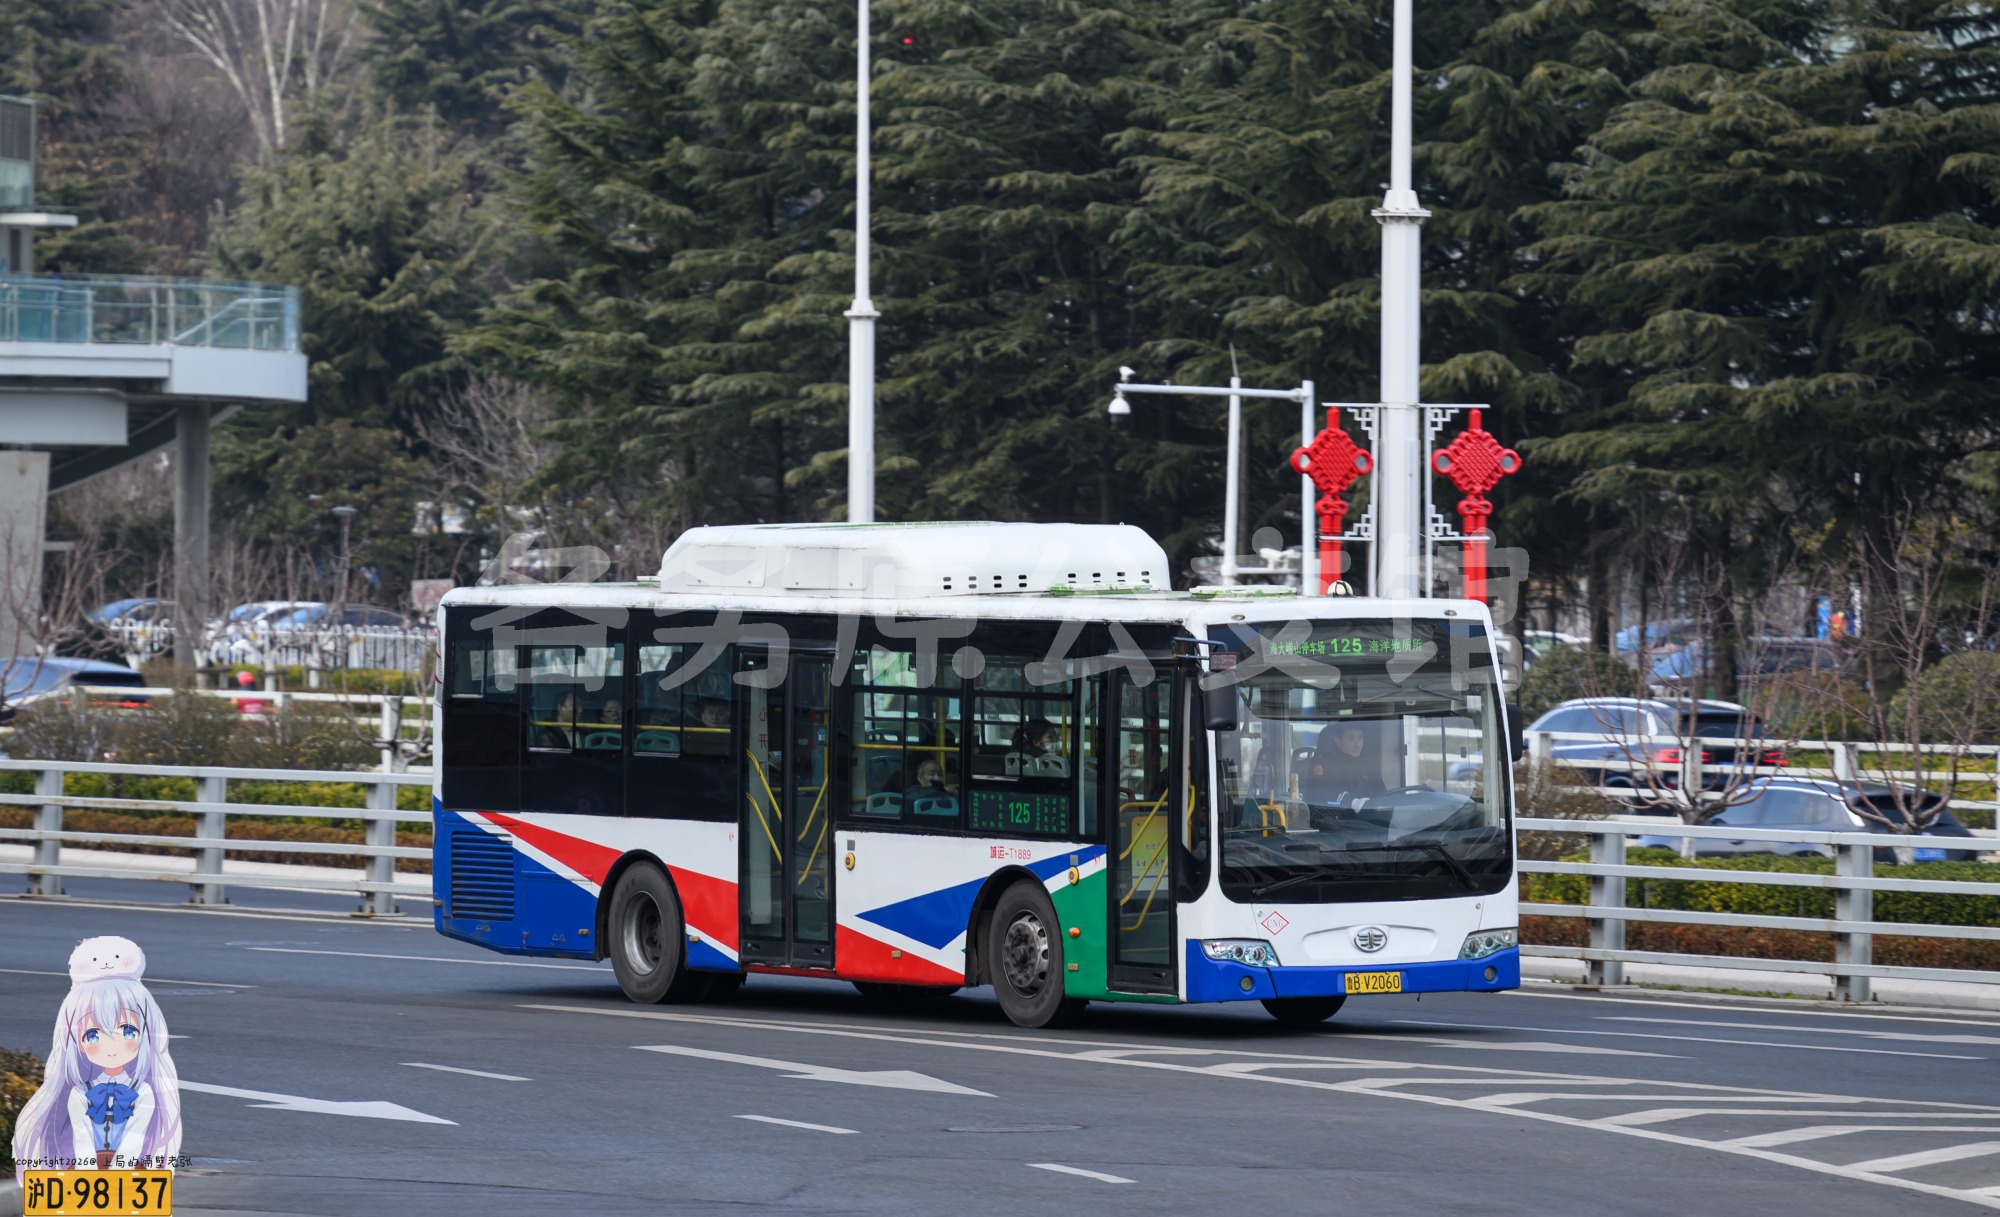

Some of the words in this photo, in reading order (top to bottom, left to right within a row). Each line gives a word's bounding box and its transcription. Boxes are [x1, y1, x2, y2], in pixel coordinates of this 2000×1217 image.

[1330, 638, 1363, 654] 125
[1368, 638, 1423, 653] 海洋地质所
[1008, 802, 1031, 824] 125
[1266, 918, 1284, 929] CNG
